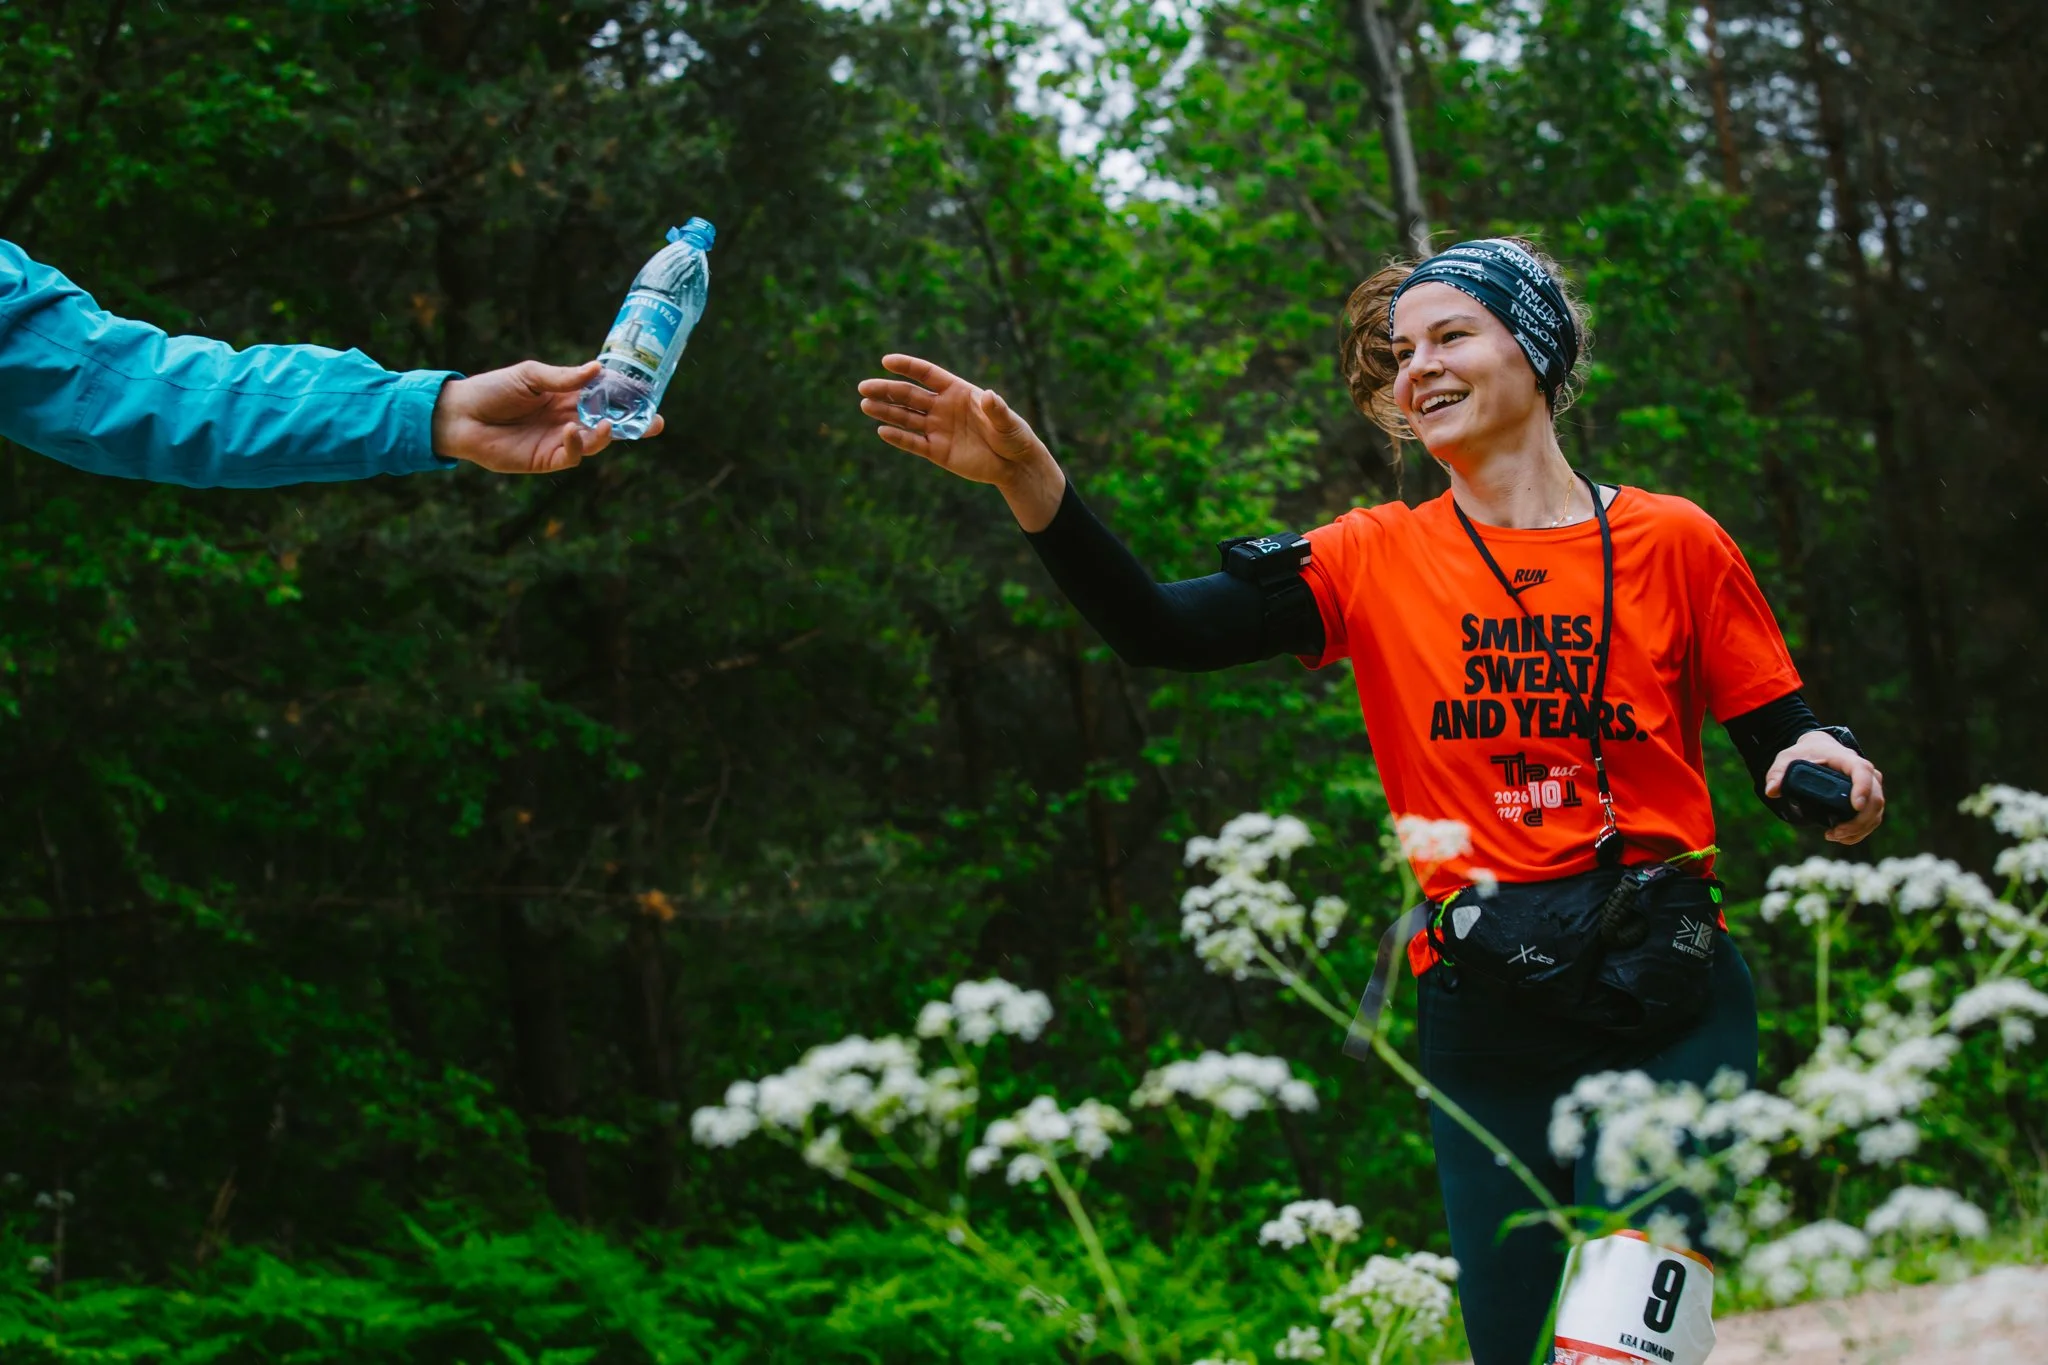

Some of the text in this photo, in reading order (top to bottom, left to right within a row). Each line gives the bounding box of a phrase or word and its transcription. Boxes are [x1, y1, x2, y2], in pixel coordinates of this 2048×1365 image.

[1515, 278, 1563, 332] TALLINN
[1513, 568, 1547, 583] RUN
[1430, 698, 1648, 742] AND YEARS.
[1494, 791, 1529, 804] 2026
[1643, 1259, 1687, 1334] 9
